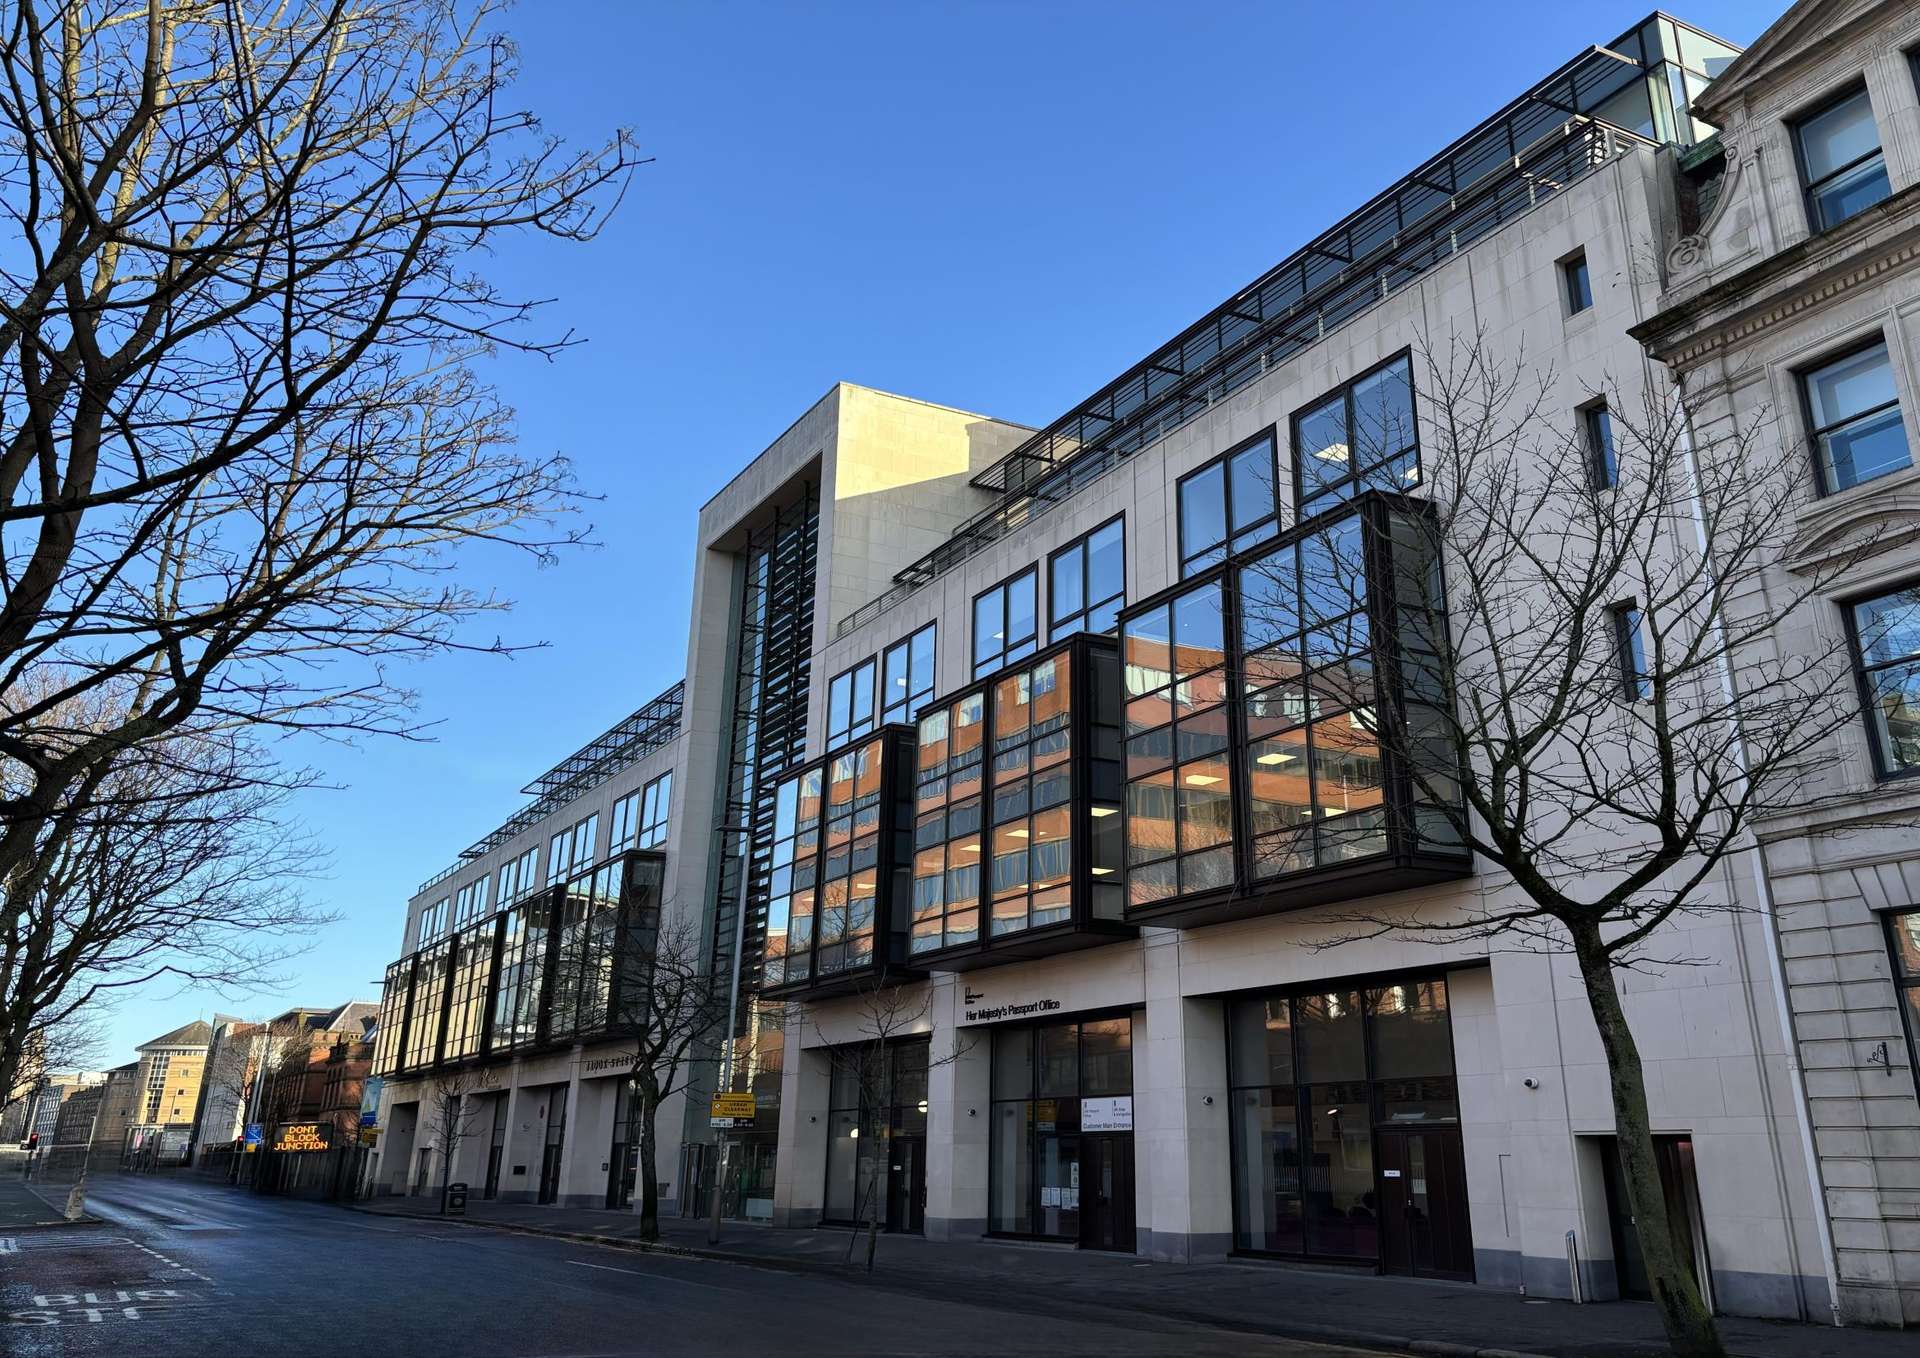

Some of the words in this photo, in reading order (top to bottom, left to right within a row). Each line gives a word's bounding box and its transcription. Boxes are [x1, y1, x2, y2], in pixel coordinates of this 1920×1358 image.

[966, 1011, 977, 1020] Her
[978, 1006, 1008, 1020] Majesty's
[1008, 1002, 1038, 1015] Passport
[1039, 999, 1061, 1011] Office
[289, 1126, 318, 1134] DONT
[284, 1133, 320, 1142] BLOCK
[274, 1141, 329, 1151] JUNCTION
